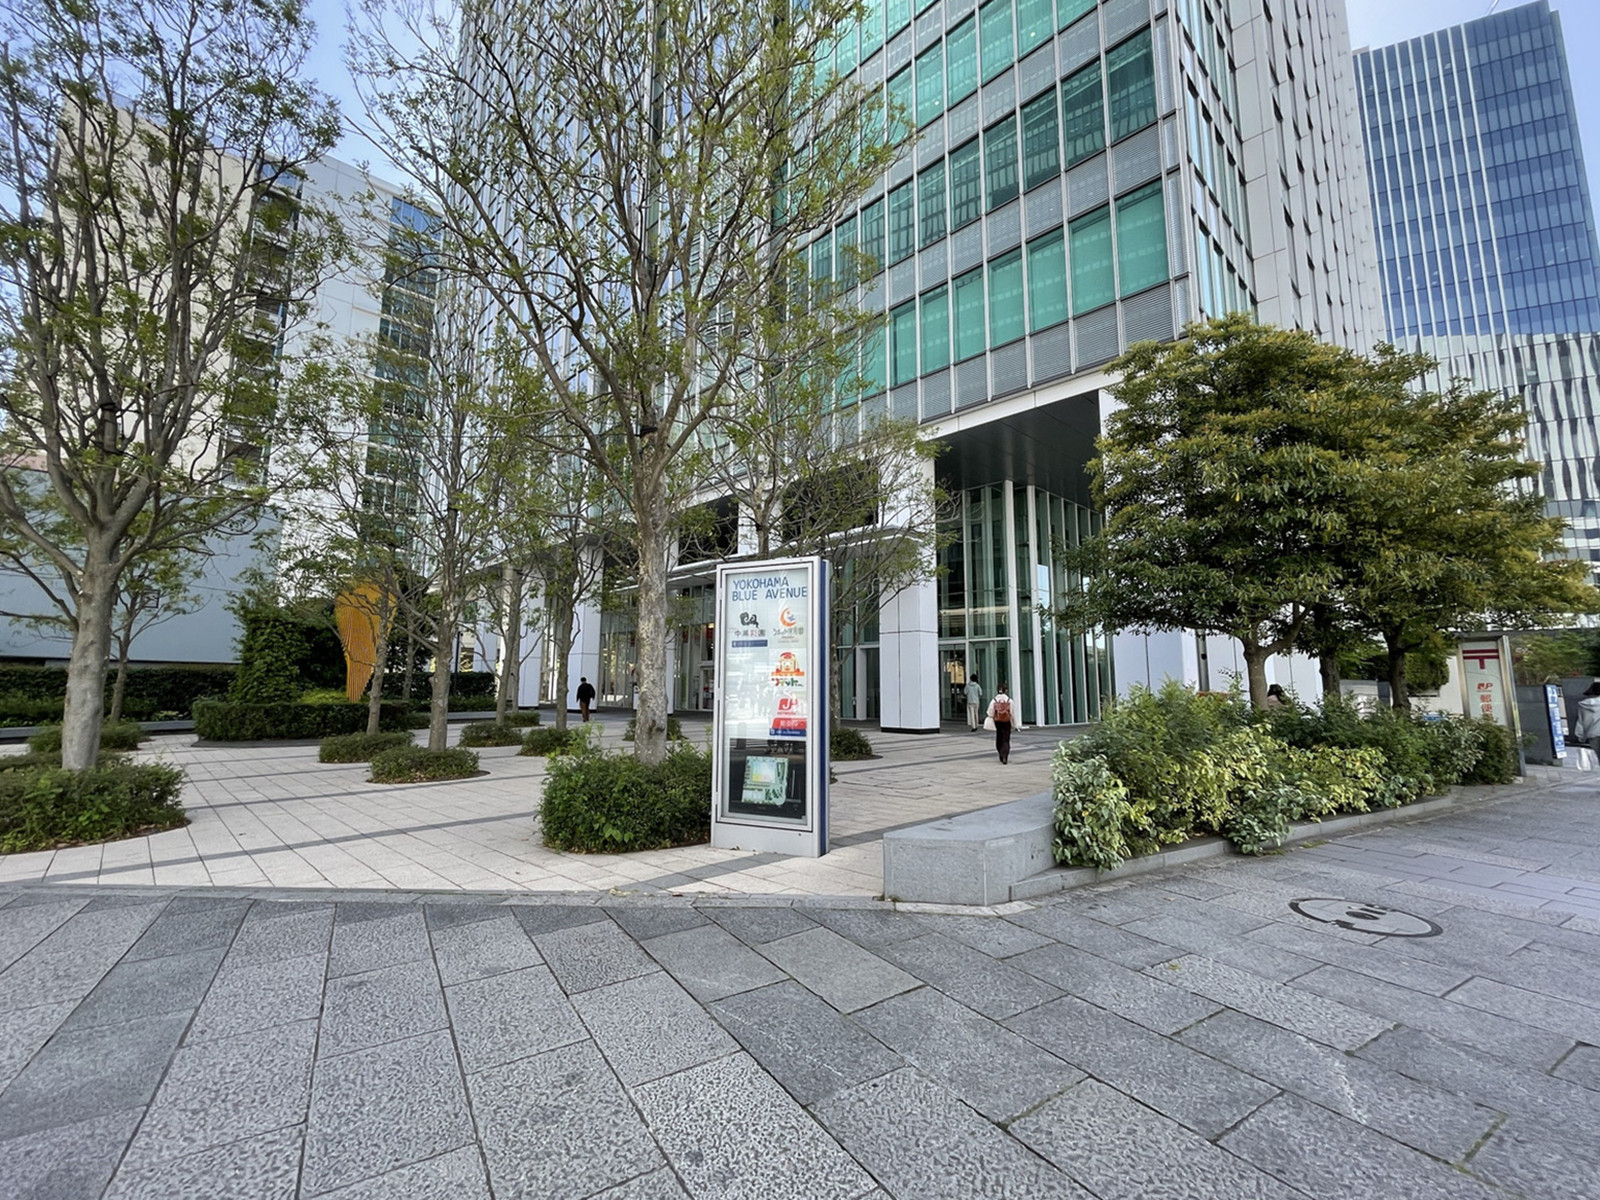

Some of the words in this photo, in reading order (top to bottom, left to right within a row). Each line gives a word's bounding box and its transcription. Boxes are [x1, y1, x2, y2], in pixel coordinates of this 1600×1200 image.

[733, 577, 789, 590] YOKOHAMA
[732, 590, 758, 602] BLUE
[765, 587, 808, 599] AVENUE
